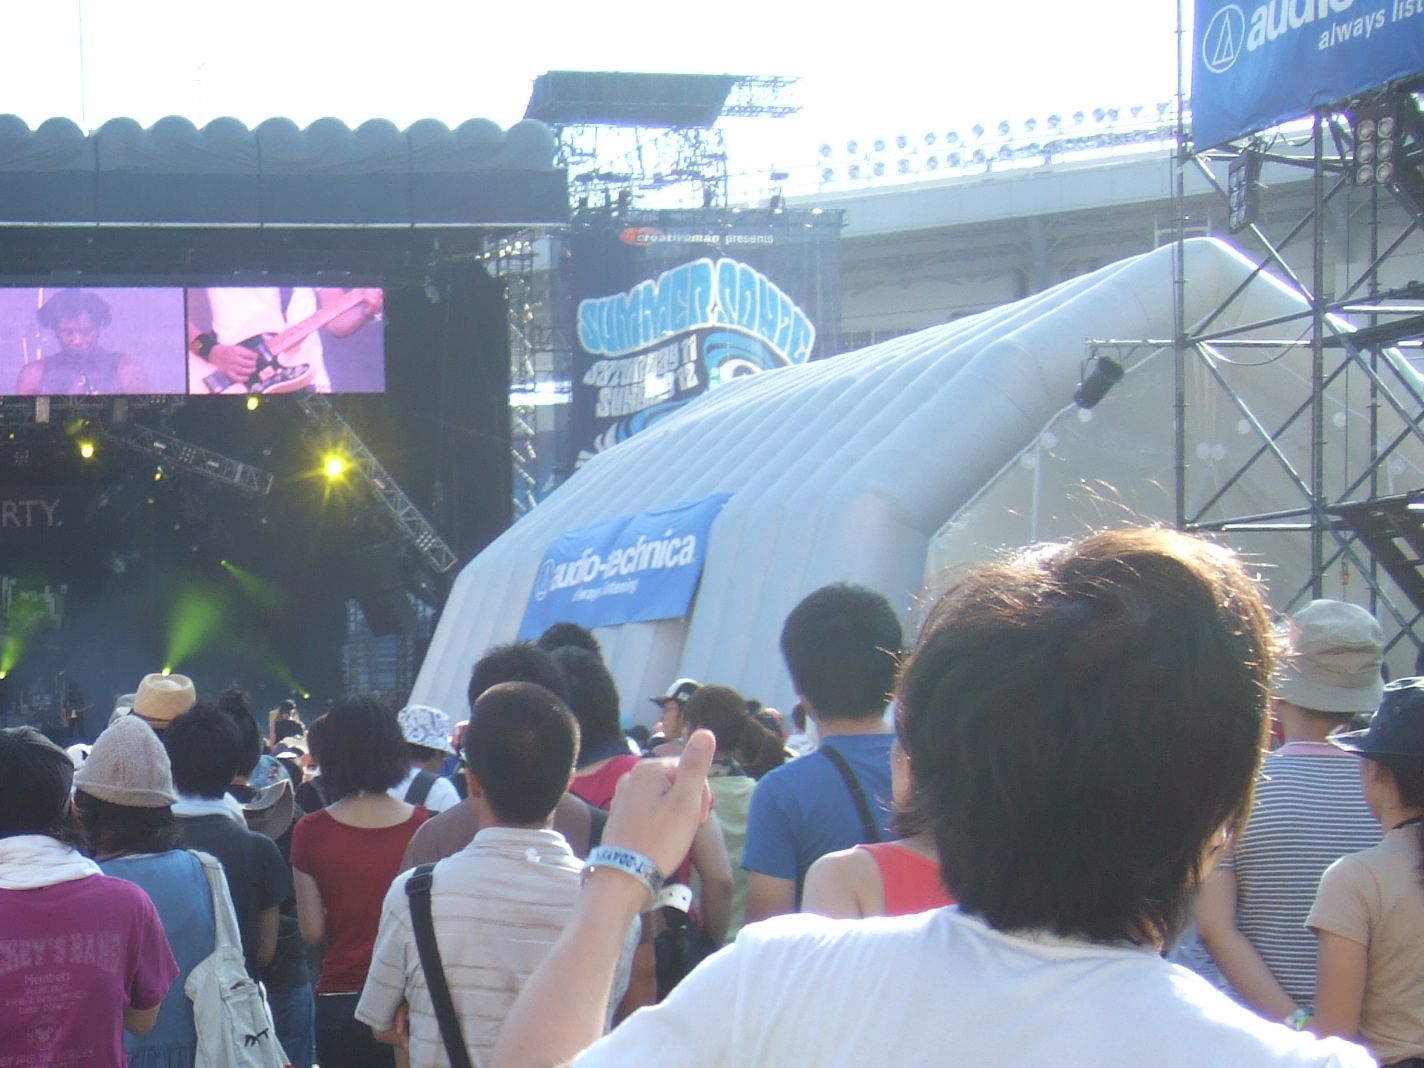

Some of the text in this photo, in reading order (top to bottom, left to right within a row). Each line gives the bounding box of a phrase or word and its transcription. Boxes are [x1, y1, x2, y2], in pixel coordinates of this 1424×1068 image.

[1247, 0, 1352, 51] aud
[1319, 9, 1386, 50] always
[725, 233, 774, 244] presents
[578, 258, 714, 357] SUMMER
